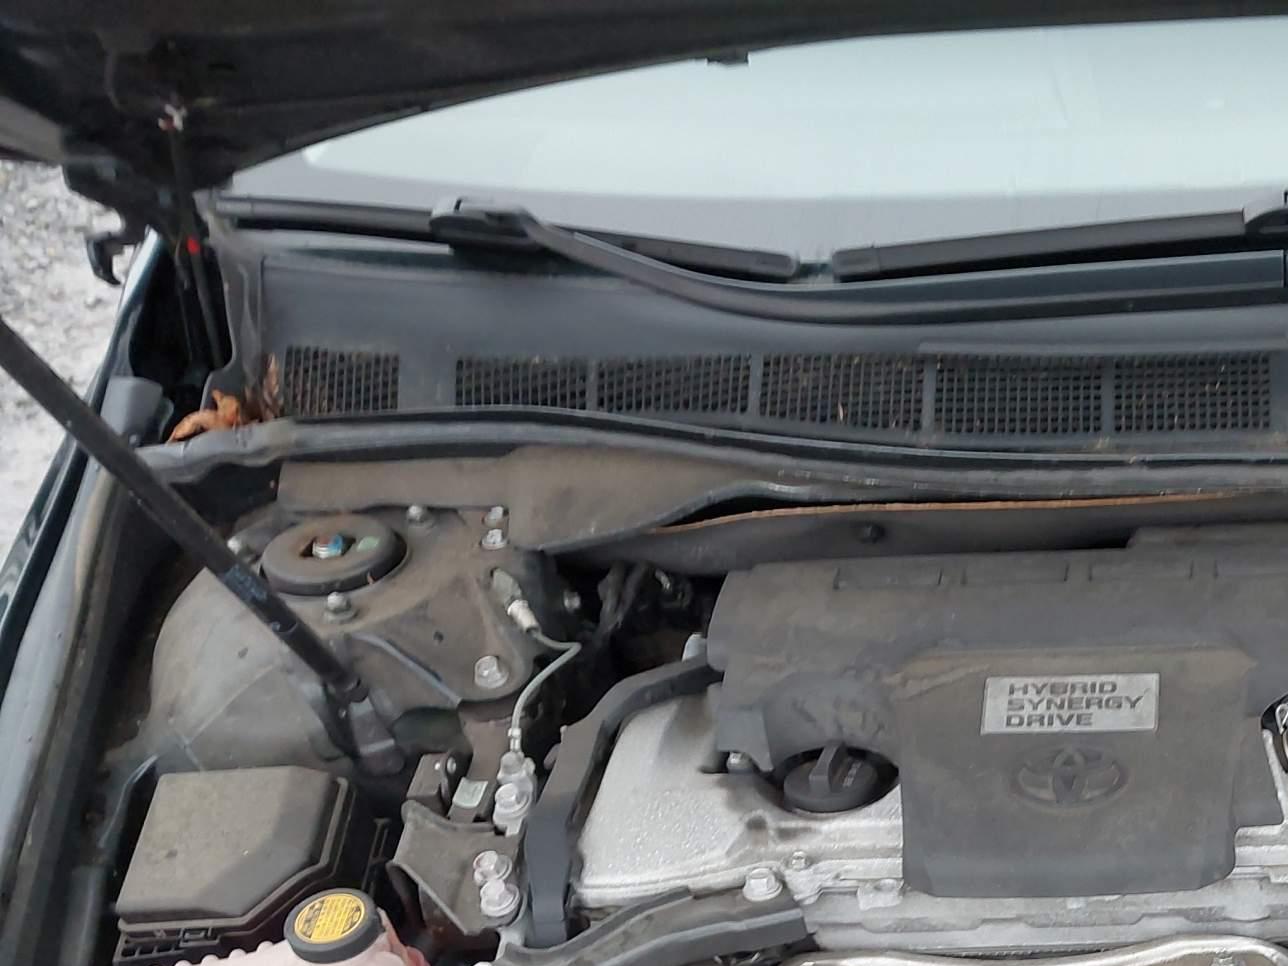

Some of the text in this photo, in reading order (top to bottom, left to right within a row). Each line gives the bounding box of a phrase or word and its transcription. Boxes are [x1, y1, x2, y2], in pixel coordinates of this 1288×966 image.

[1008, 681, 1118, 696] HYBRID
[1007, 695, 1143, 711] SYNERGY
[1005, 712, 1093, 728] DRIVE
